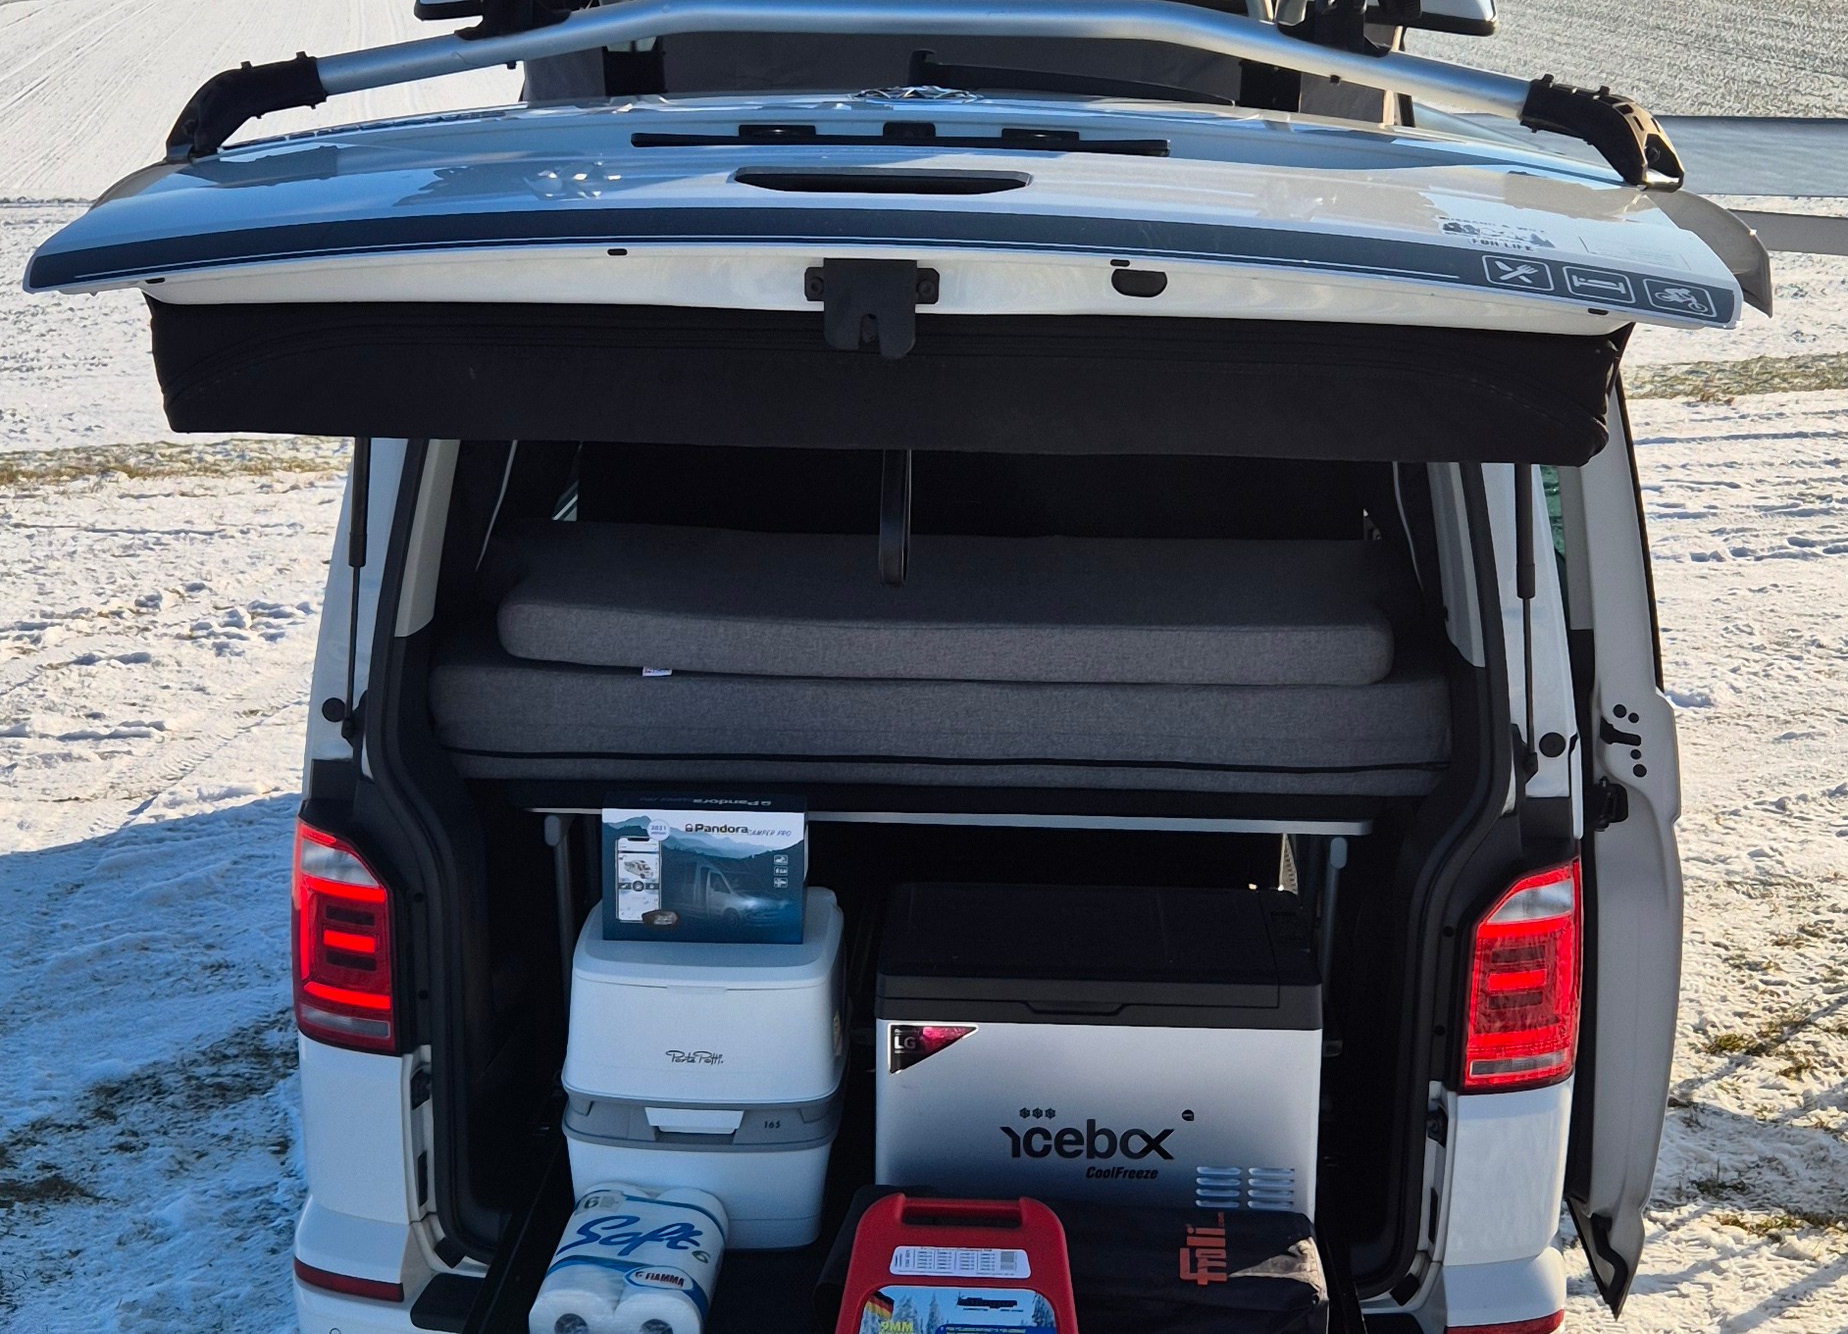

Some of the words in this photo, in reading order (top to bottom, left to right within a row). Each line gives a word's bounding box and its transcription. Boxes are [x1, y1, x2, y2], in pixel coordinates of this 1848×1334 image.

[694, 823, 749, 834] Pandora
[894, 1036, 916, 1049] LG
[764, 1120, 781, 1129] 165
[1085, 1166, 1159, 1181] CoolFreeze
[556, 1215, 703, 1257] Soft
[645, 1271, 686, 1288] FIAMMA
